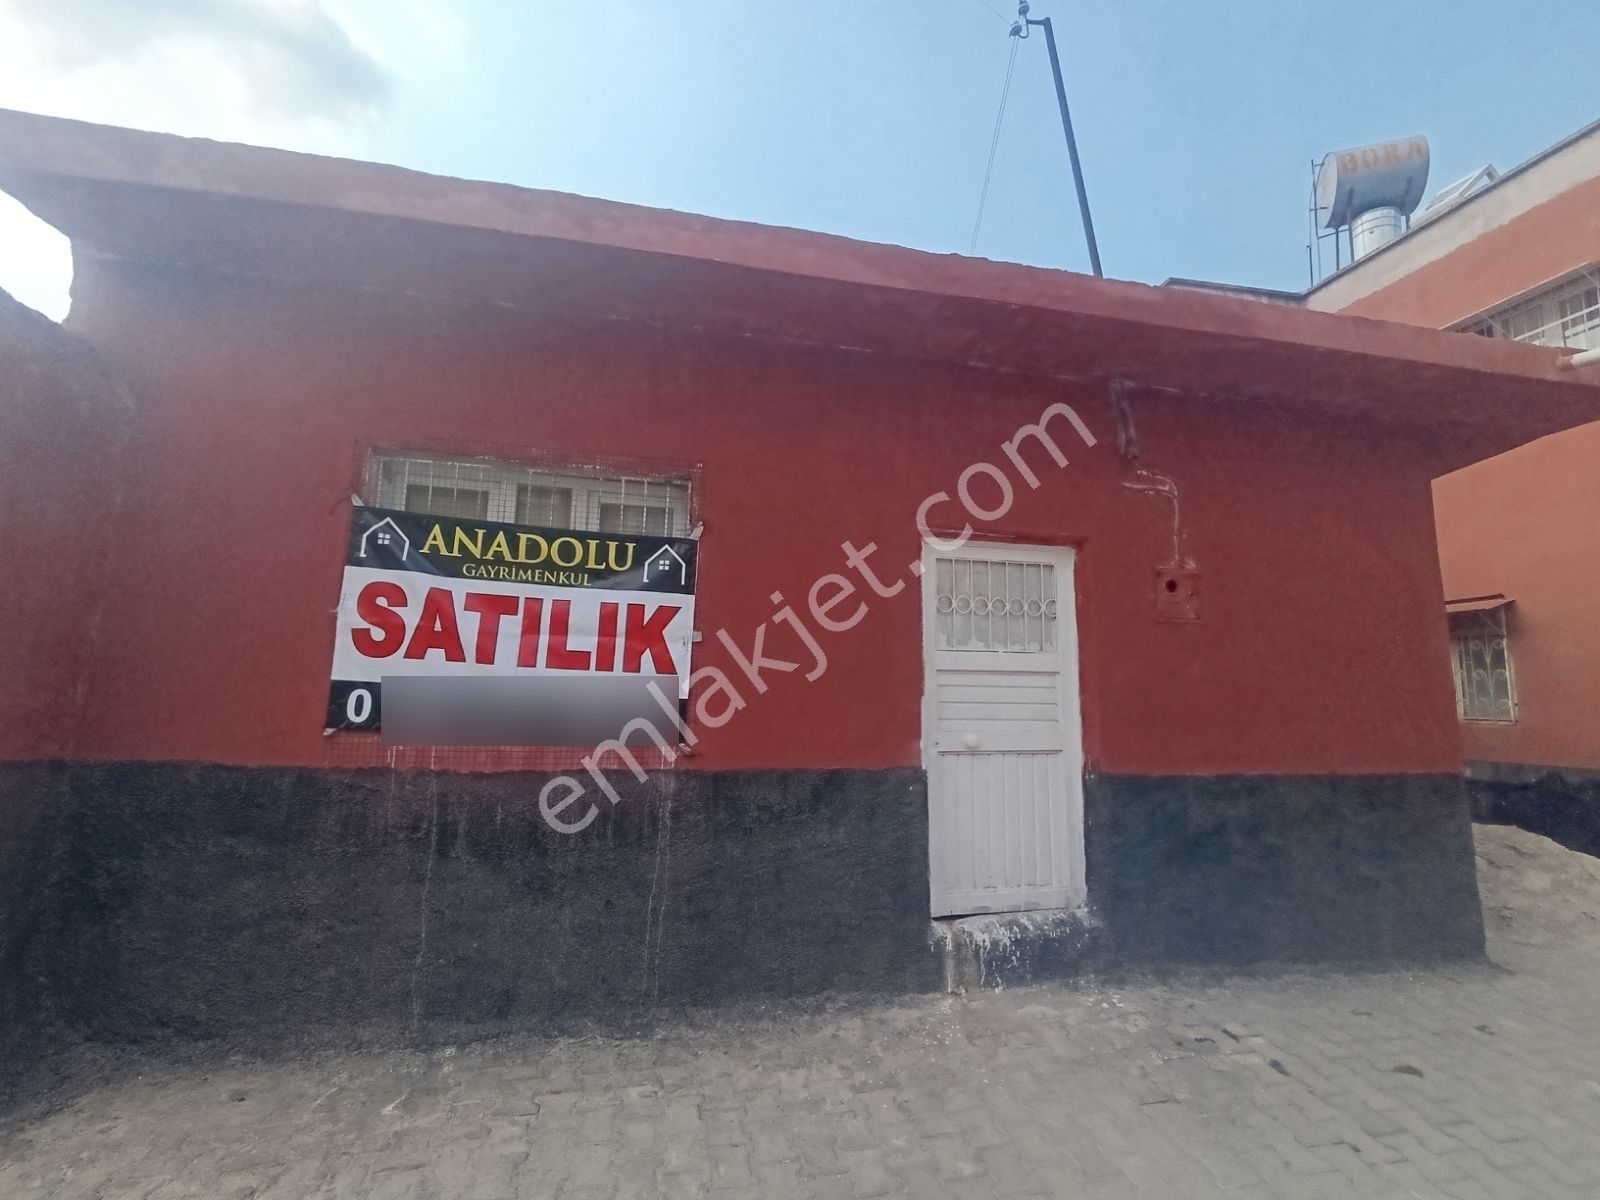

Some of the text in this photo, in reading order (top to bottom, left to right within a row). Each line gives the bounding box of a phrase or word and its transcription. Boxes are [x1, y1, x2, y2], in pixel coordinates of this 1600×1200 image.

[419, 523, 637, 572] ANADOLU
[462, 563, 592, 586] GAYRİMENKUL
[351, 581, 682, 675] SATILIK
[346, 688, 372, 723] 0
